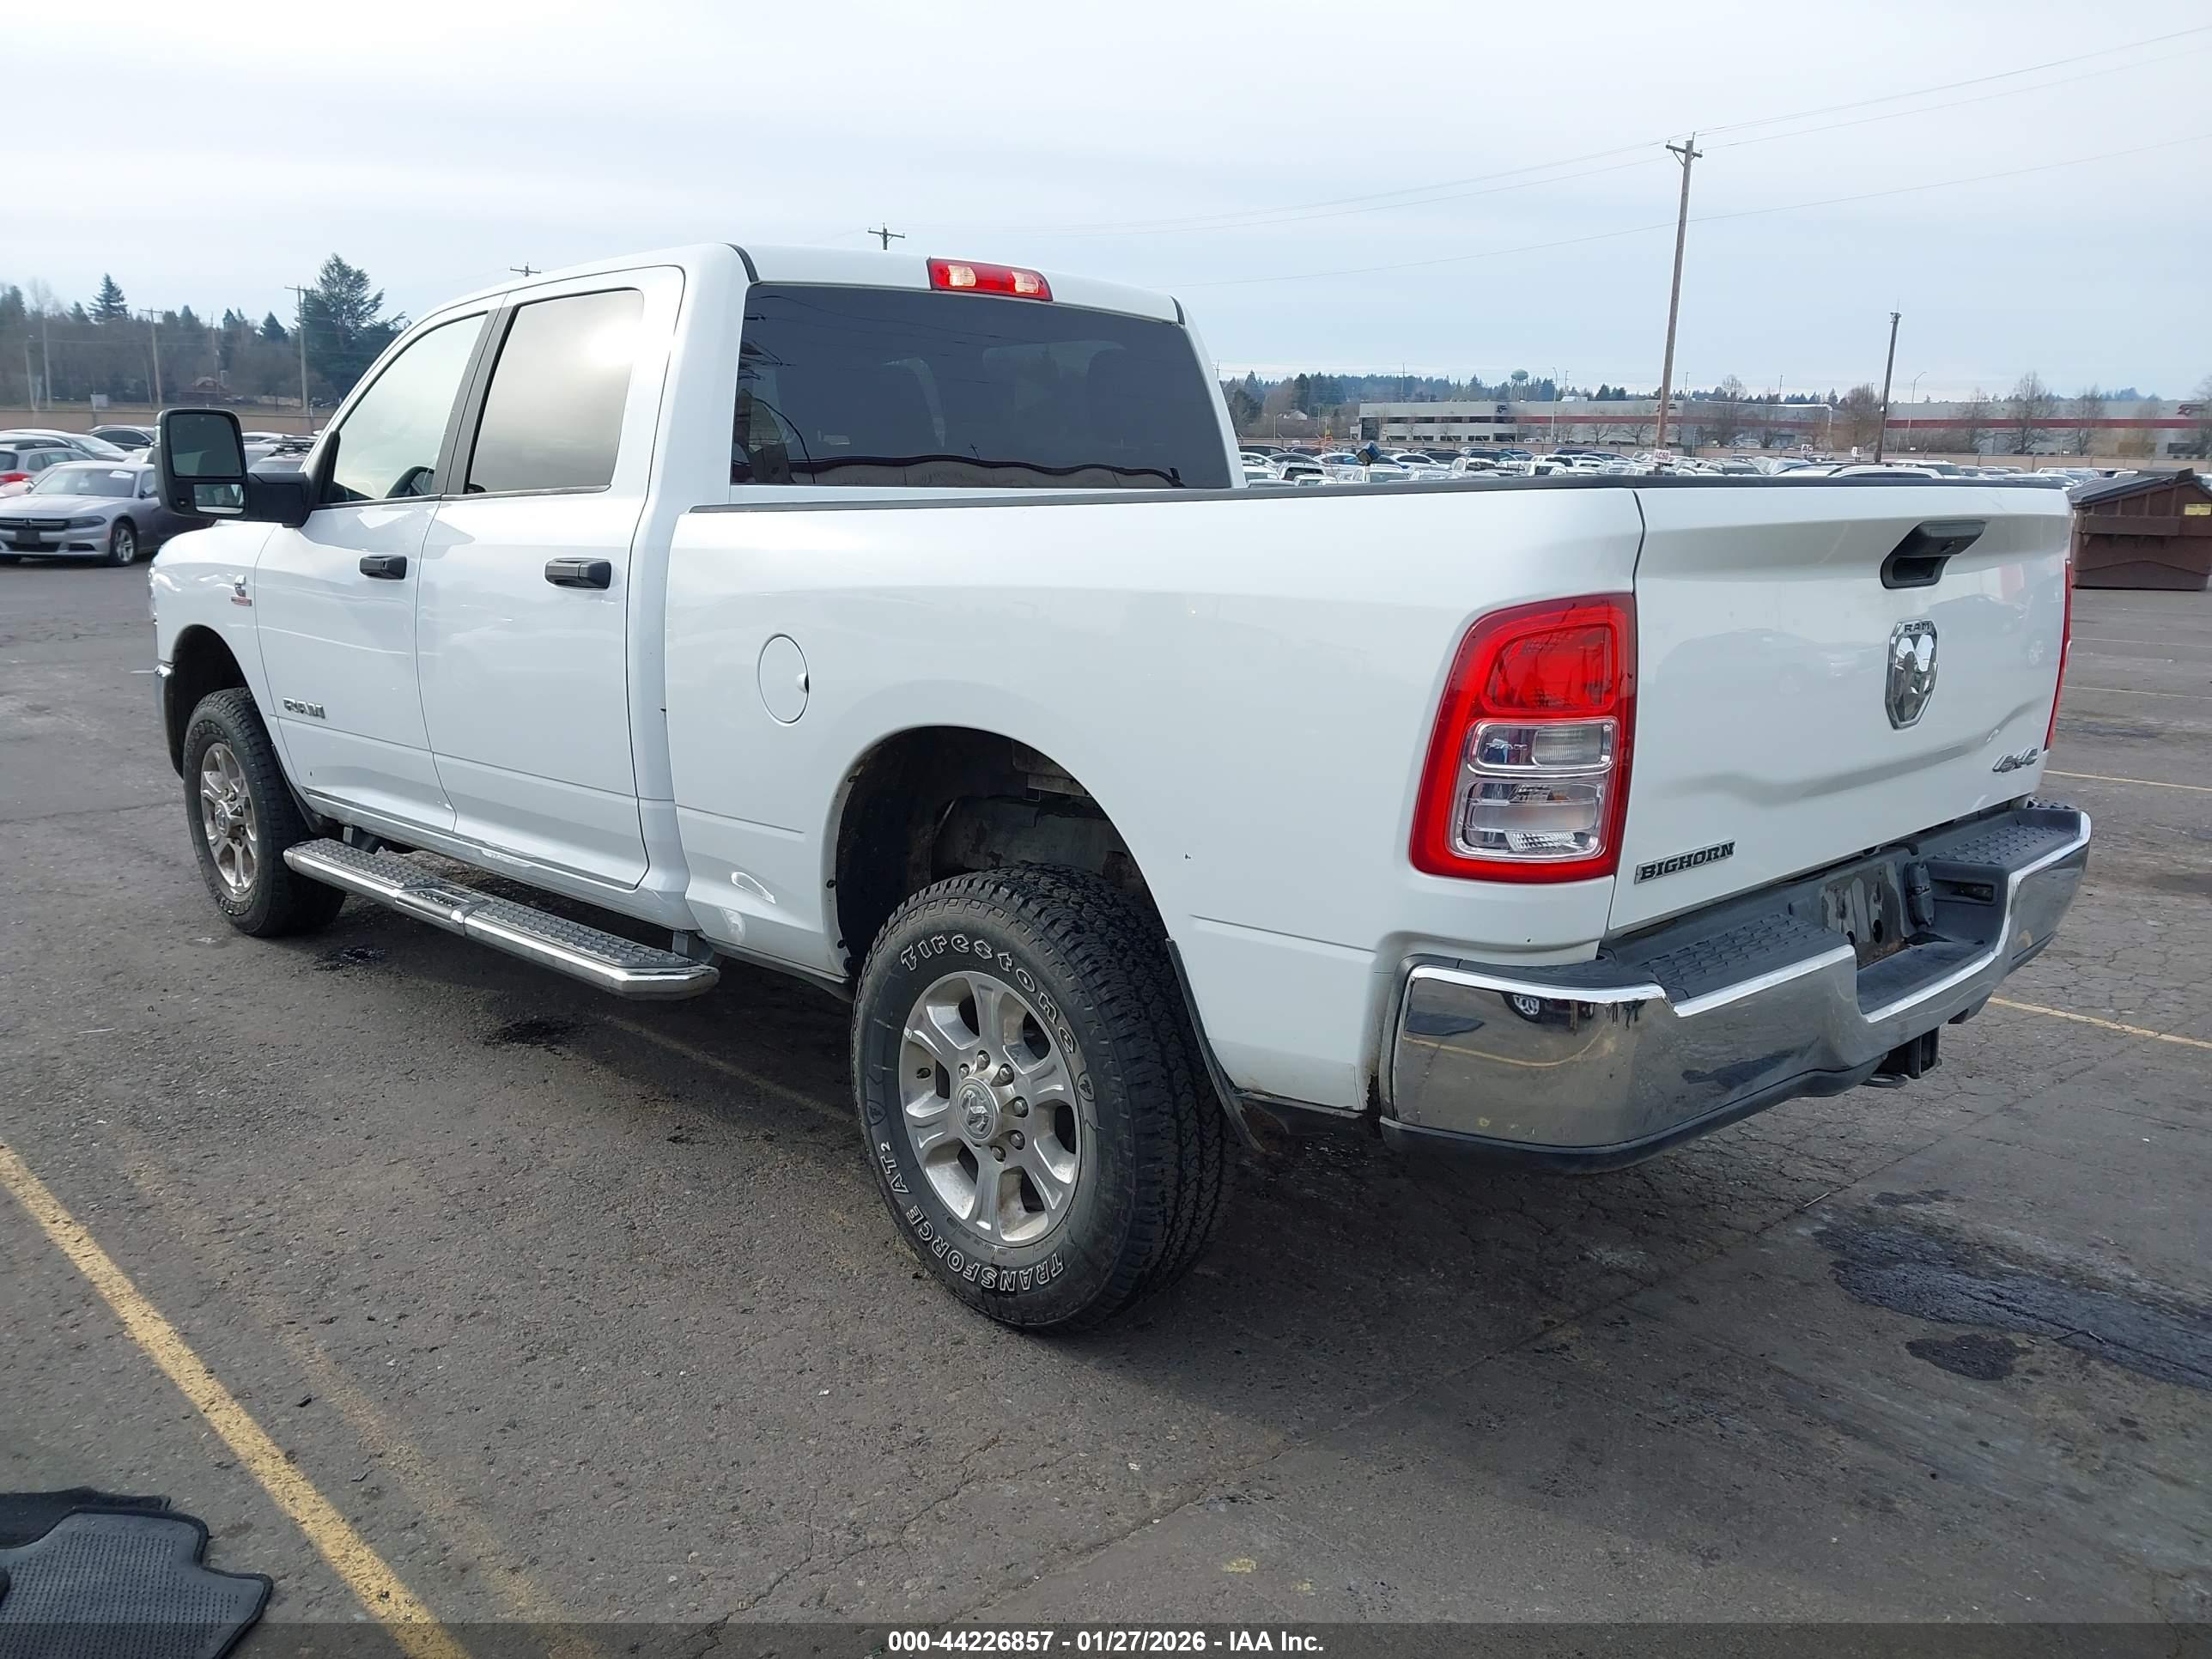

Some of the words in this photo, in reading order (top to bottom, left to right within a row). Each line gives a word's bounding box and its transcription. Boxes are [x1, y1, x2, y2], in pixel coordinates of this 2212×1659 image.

[1904, 623, 1931, 632] RAM
[283, 697, 325, 719] RAM
[1640, 842, 1735, 880] BIGHORN
[901, 933, 1074, 1054] Firestone
[906, 1205, 1064, 1291] TRANSFORCE
